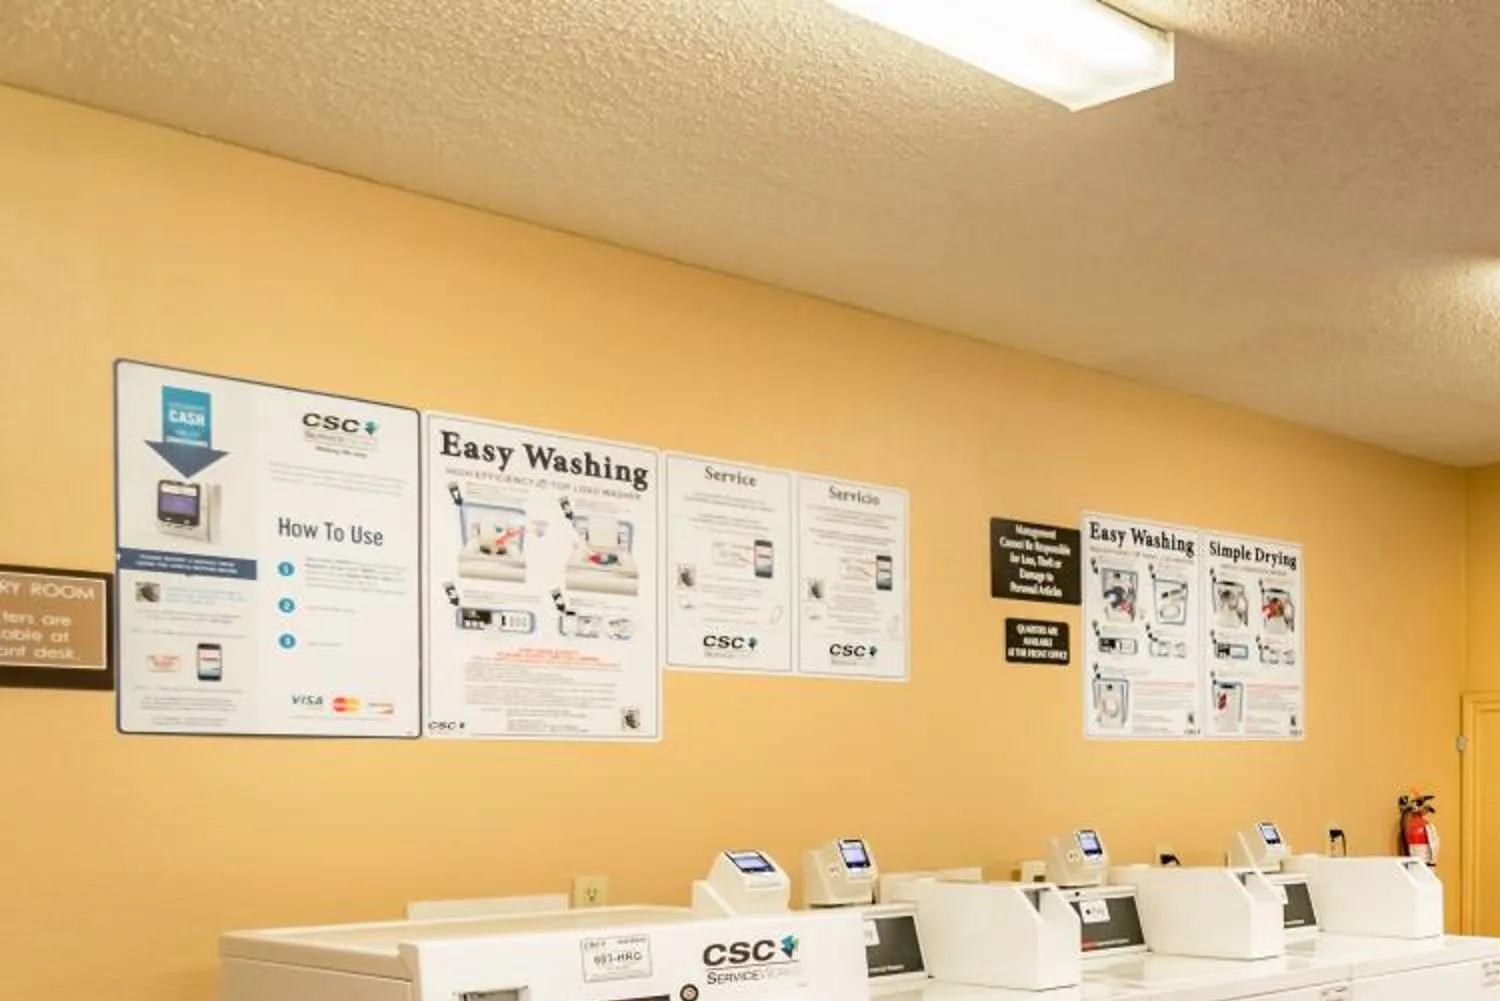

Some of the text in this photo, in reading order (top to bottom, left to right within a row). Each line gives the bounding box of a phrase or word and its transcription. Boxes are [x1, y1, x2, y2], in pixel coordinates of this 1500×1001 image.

[168, 409, 205, 427] CASH
[302, 412, 361, 433] CSC
[439, 430, 649, 492] Easy Washing
[704, 466, 757, 487] Service
[828, 485, 881, 506] Servicio
[278, 517, 384, 546] How To Use
[1089, 521, 1127, 548] Easy
[1130, 527, 1195, 558] Washing
[1209, 540, 1252, 564] Simple
[1255, 547, 1297, 571] Drying
[31, 582, 95, 600] ROOM
[41, 614, 72, 627] are
[50, 632, 69, 643] at
[703, 635, 745, 650] CSC
[829, 643, 867, 658] CSC
[291, 695, 324, 706] VISA
[703, 939, 776, 967] CSC
